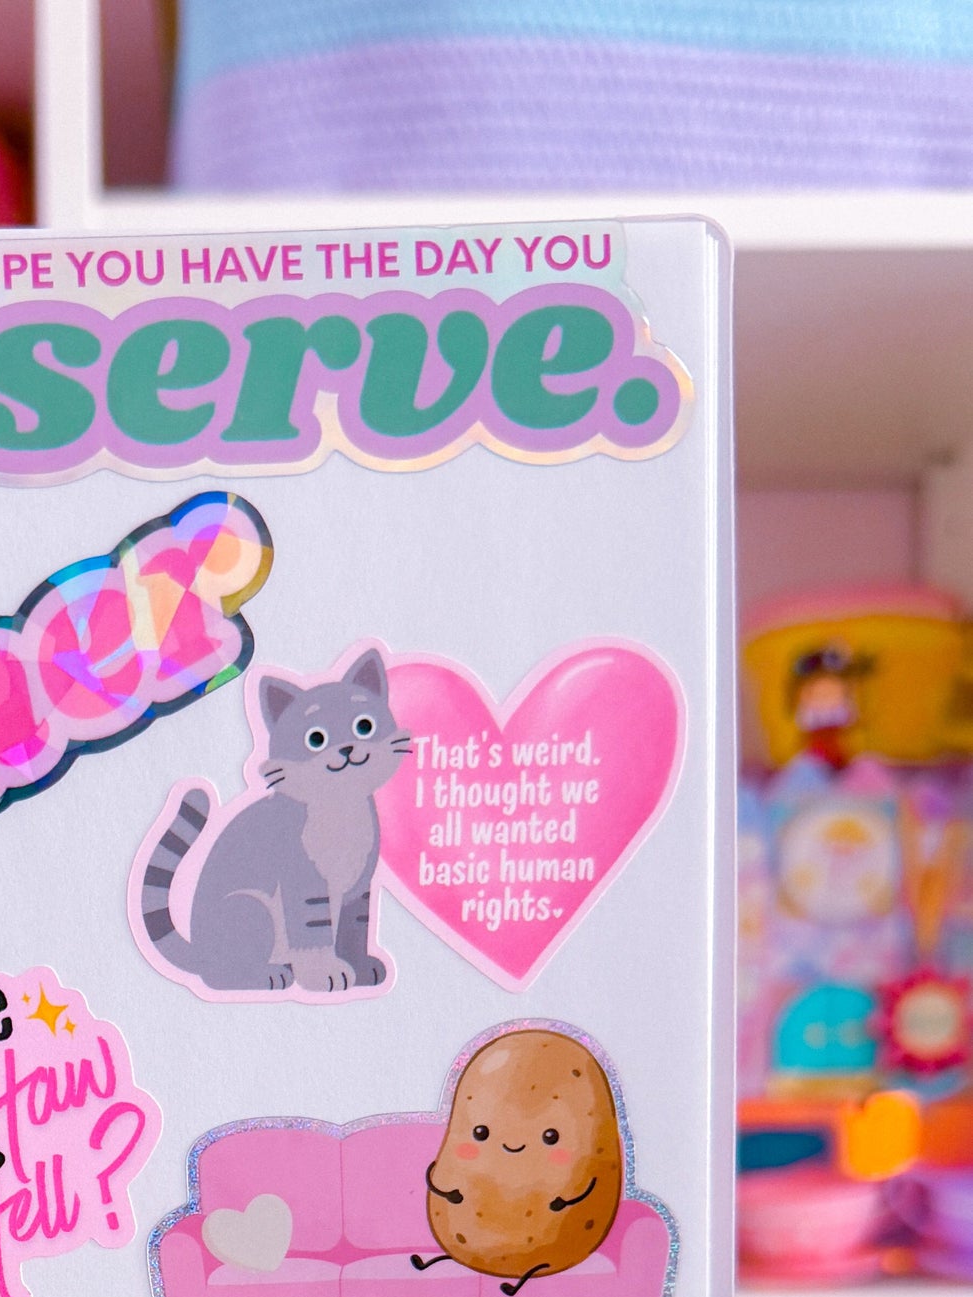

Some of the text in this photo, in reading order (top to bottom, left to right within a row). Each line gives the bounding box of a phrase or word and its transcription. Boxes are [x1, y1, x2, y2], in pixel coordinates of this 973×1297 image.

[65, 248, 176, 287] YOU
[181, 243, 305, 286] HAVE
[317, 242, 403, 280] THE
[415, 236, 503, 275] DAY
[518, 232, 614, 273] YOU
[413, 730, 602, 770] That's weird.
[415, 770, 600, 816] I thought we
[428, 808, 577, 847] all wanted
[418, 848, 595, 886] basic human
